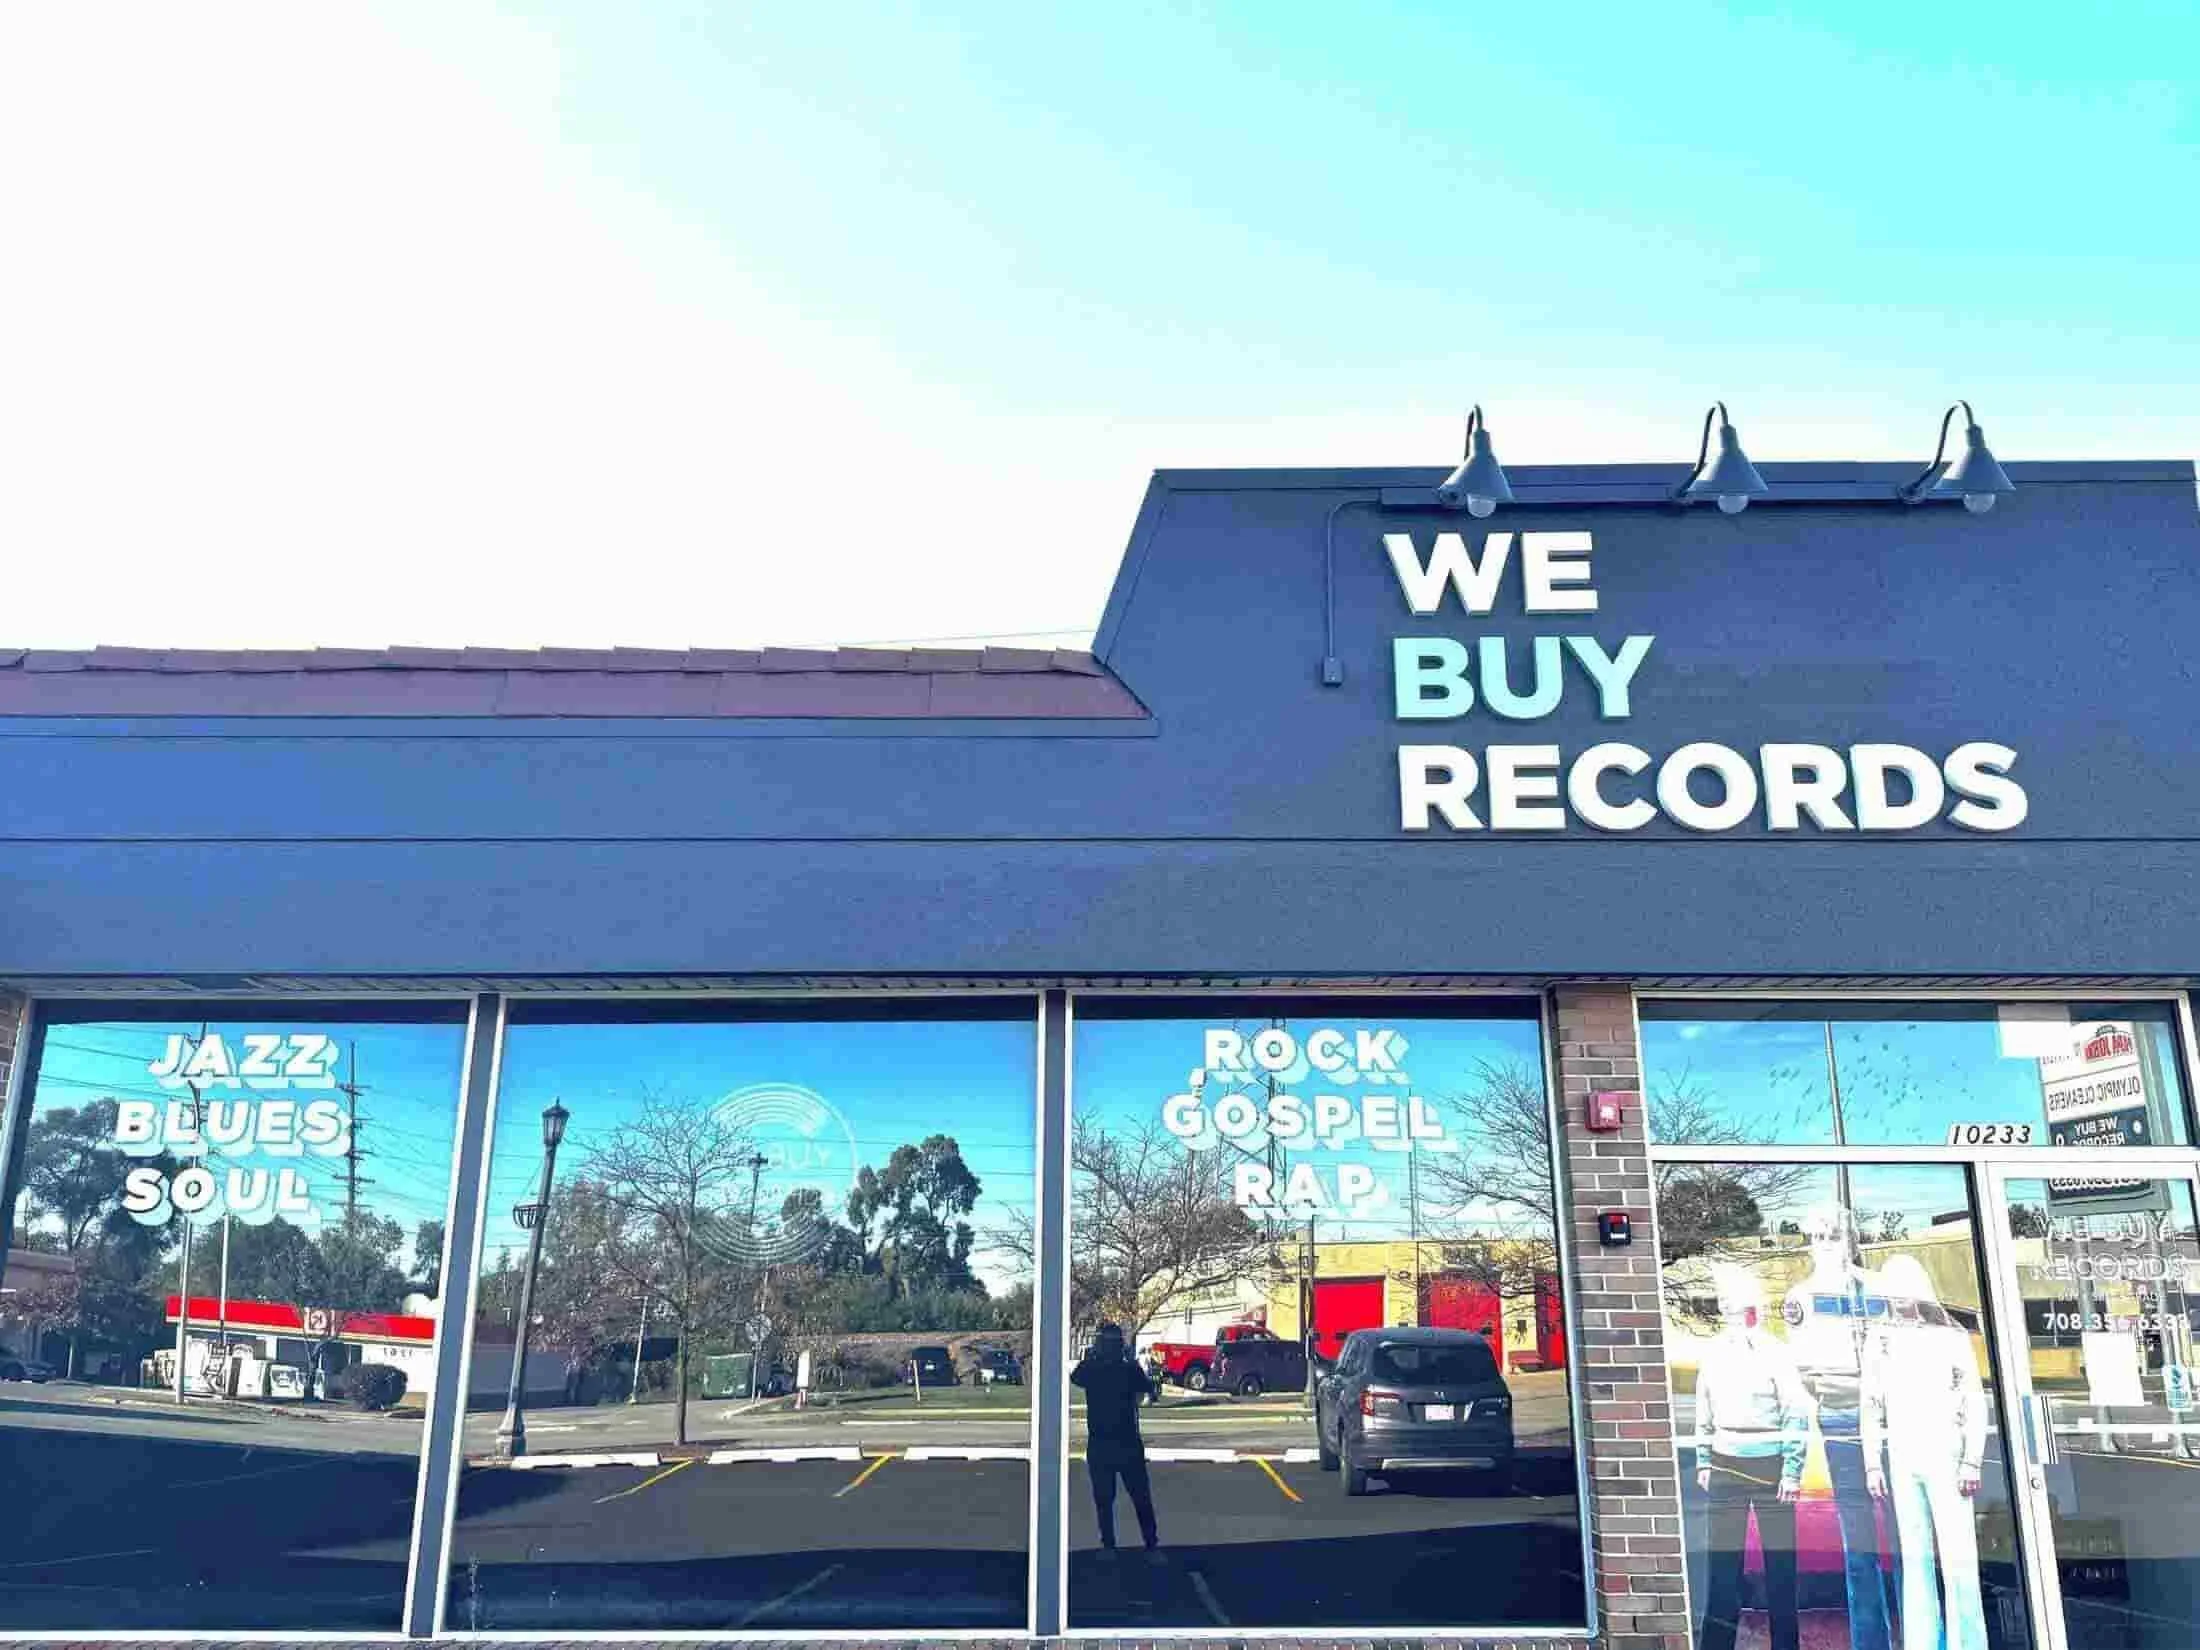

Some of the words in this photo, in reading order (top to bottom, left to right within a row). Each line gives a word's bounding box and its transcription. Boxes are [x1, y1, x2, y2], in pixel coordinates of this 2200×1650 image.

[1384, 531, 1599, 615] WE
[1393, 634, 1656, 720] BUY
[1398, 742, 2028, 832] RECORDS
[150, 1034, 332, 1082] JAZZ
[1204, 1029, 1402, 1075] ROCK
[115, 1100, 348, 1148] BLUES
[1162, 1094, 1448, 1142] GOSPEL
[1953, 1125, 2031, 1144] 10233
[123, 1167, 314, 1216] SOUL
[1235, 1163, 1380, 1211] RAP
